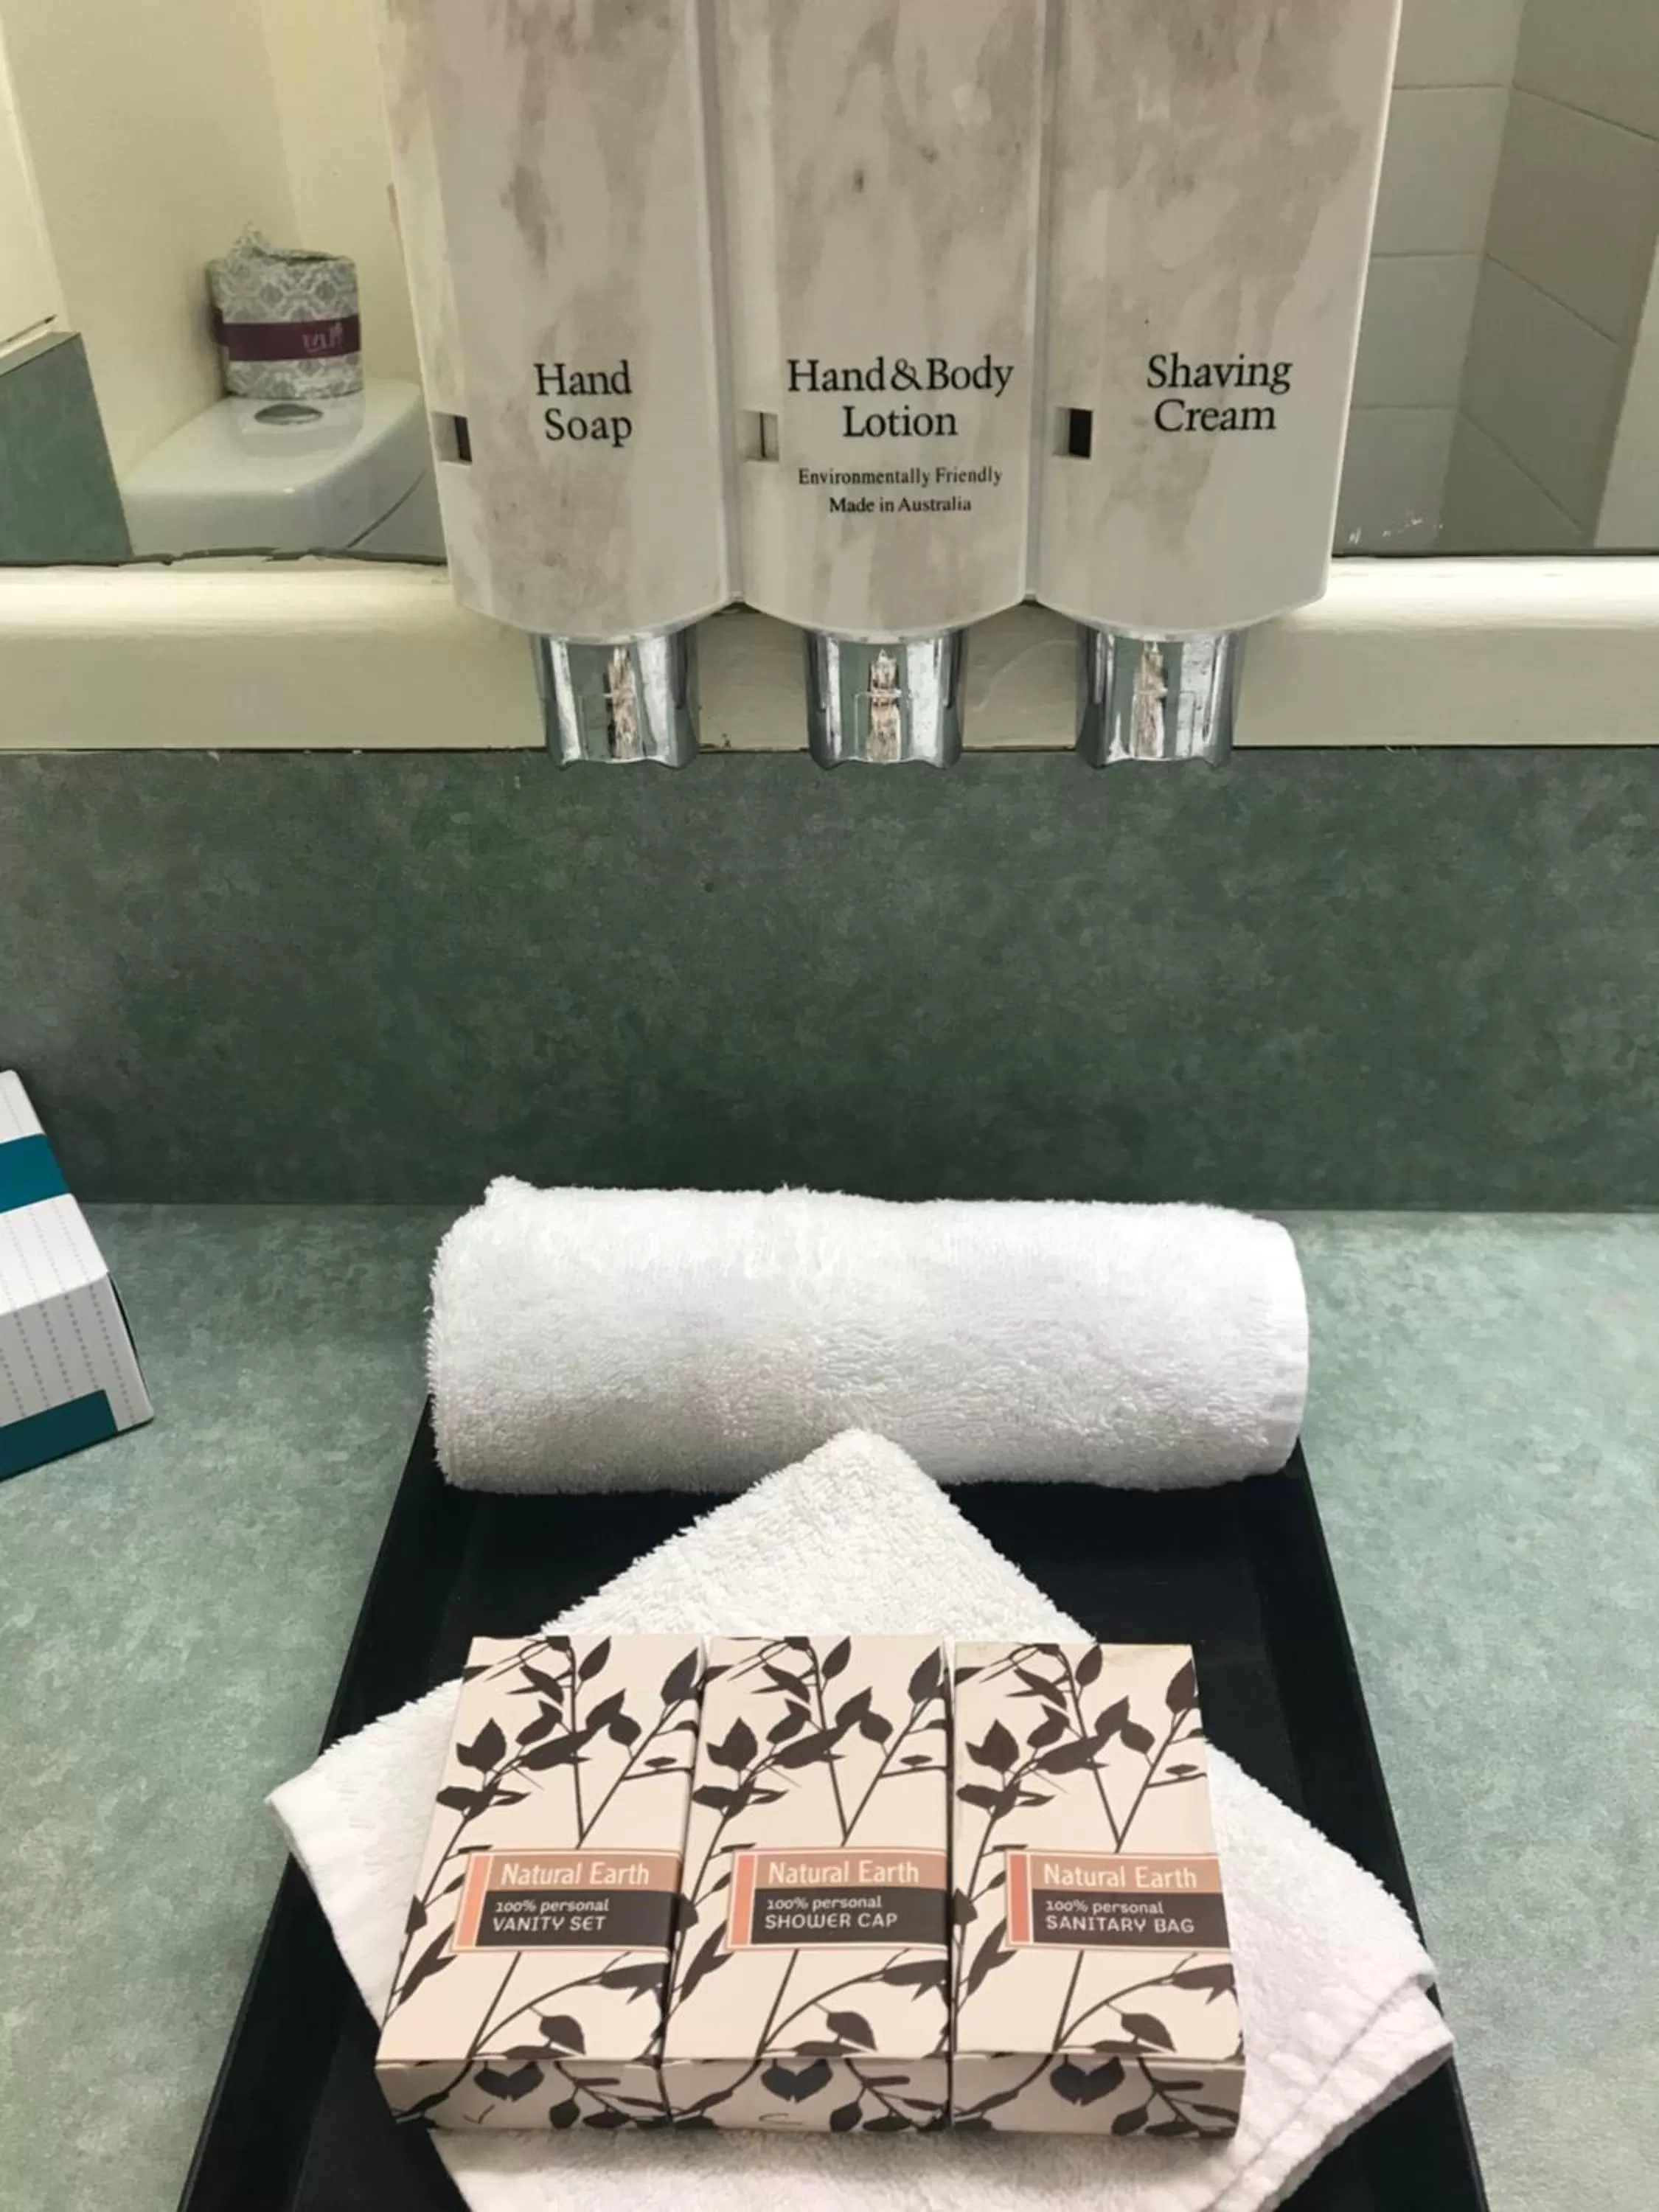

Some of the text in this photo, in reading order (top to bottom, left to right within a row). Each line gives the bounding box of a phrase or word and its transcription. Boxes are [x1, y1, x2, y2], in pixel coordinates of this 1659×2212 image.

[534, 359, 633, 396] Hand
[787, 354, 1014, 397] Hand&Body
[1147, 352, 1293, 395] Shaving
[843, 405, 959, 438] Lotion
[1154, 398, 1276, 433] Cream
[545, 408, 633, 448] Soap
[799, 466, 1003, 488] Environmentally Friendly
[830, 496, 972, 514] Made in Australia
[501, 1861, 650, 1885] Natural Earth
[768, 1860, 920, 1885] Natural Earth
[1043, 1863, 1198, 1889] Natural Earth
[495, 1899, 610, 1915] 100% personal
[767, 1896, 883, 1913] 100% personal
[1046, 1899, 1164, 1916] 100% personal
[493, 1916, 607, 1933] VANITY SET
[765, 1913, 898, 1930] SHOWER CAP
[1046, 1915, 1195, 1934] SANITARY BAG
